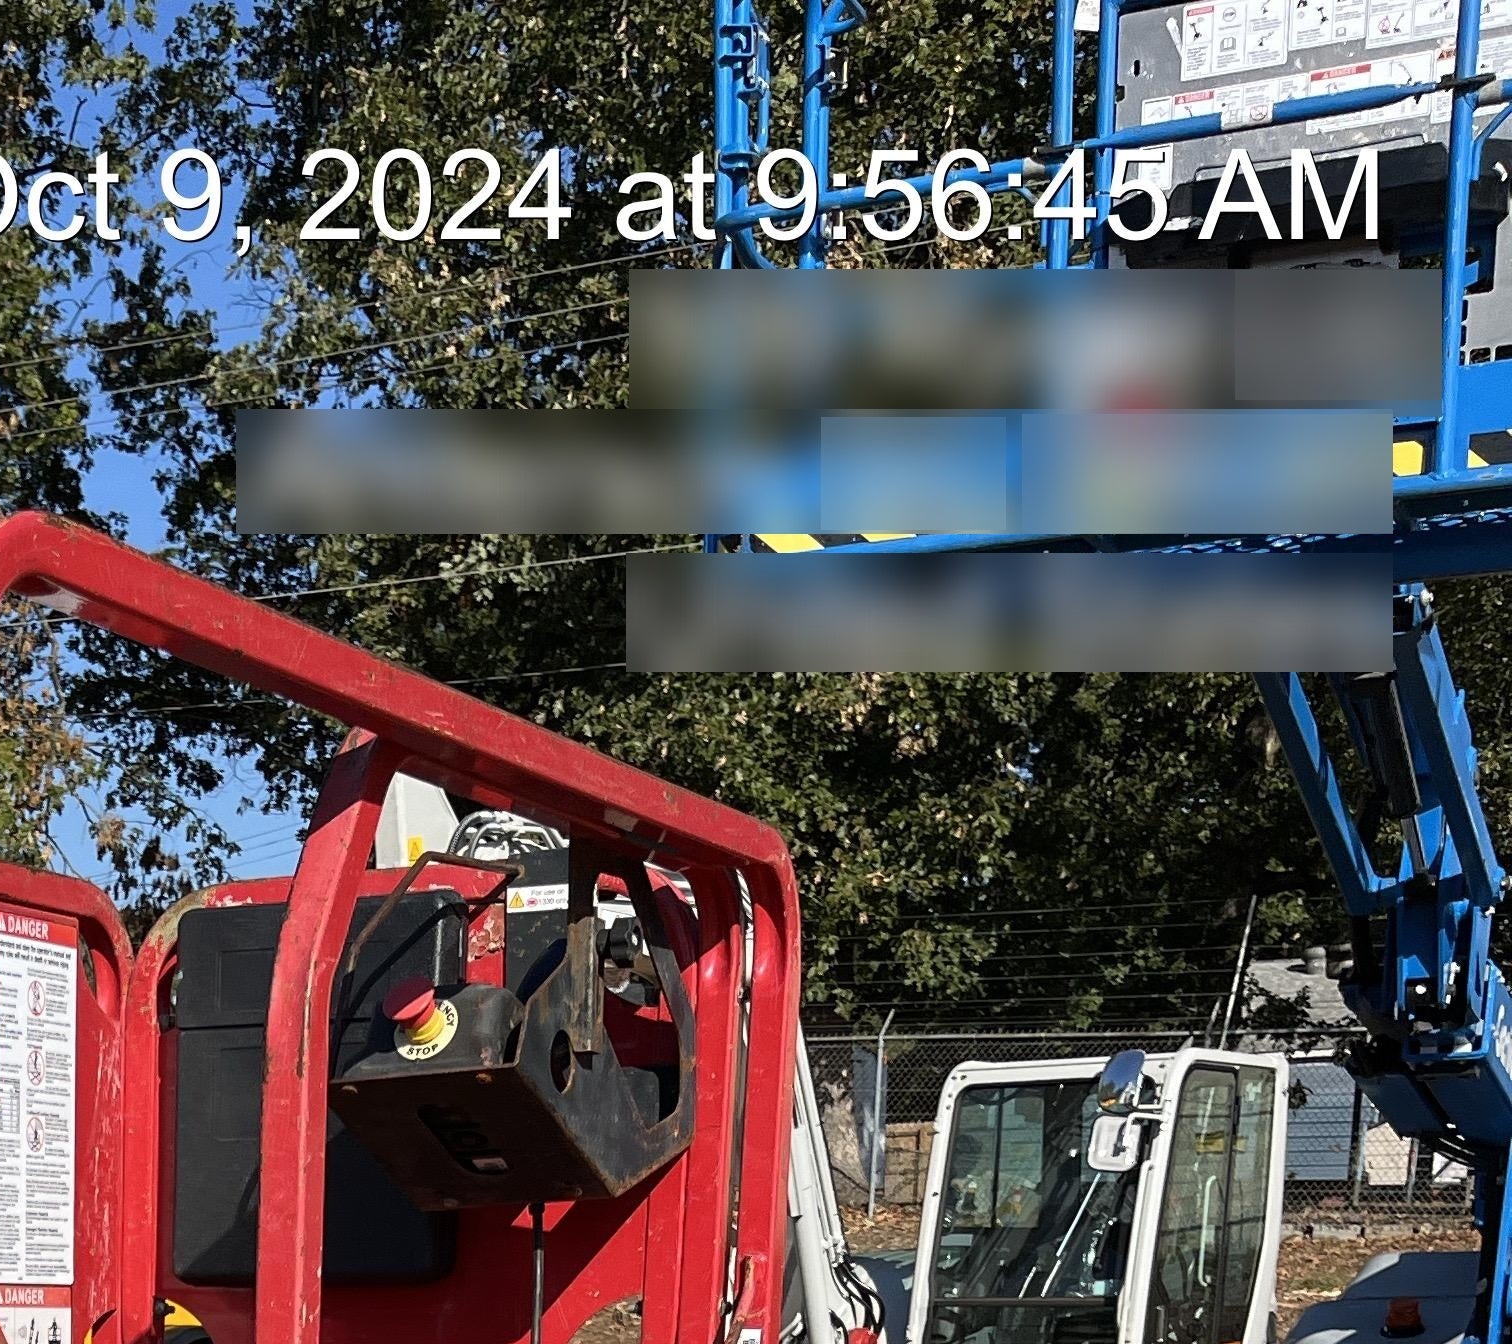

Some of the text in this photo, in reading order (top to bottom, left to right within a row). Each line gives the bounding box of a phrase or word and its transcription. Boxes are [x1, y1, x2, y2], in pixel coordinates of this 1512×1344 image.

[7, 914, 49, 940] DANGER
[407, 1044, 439, 1056] STOP
[4, 1287, 44, 1305] DANGER
